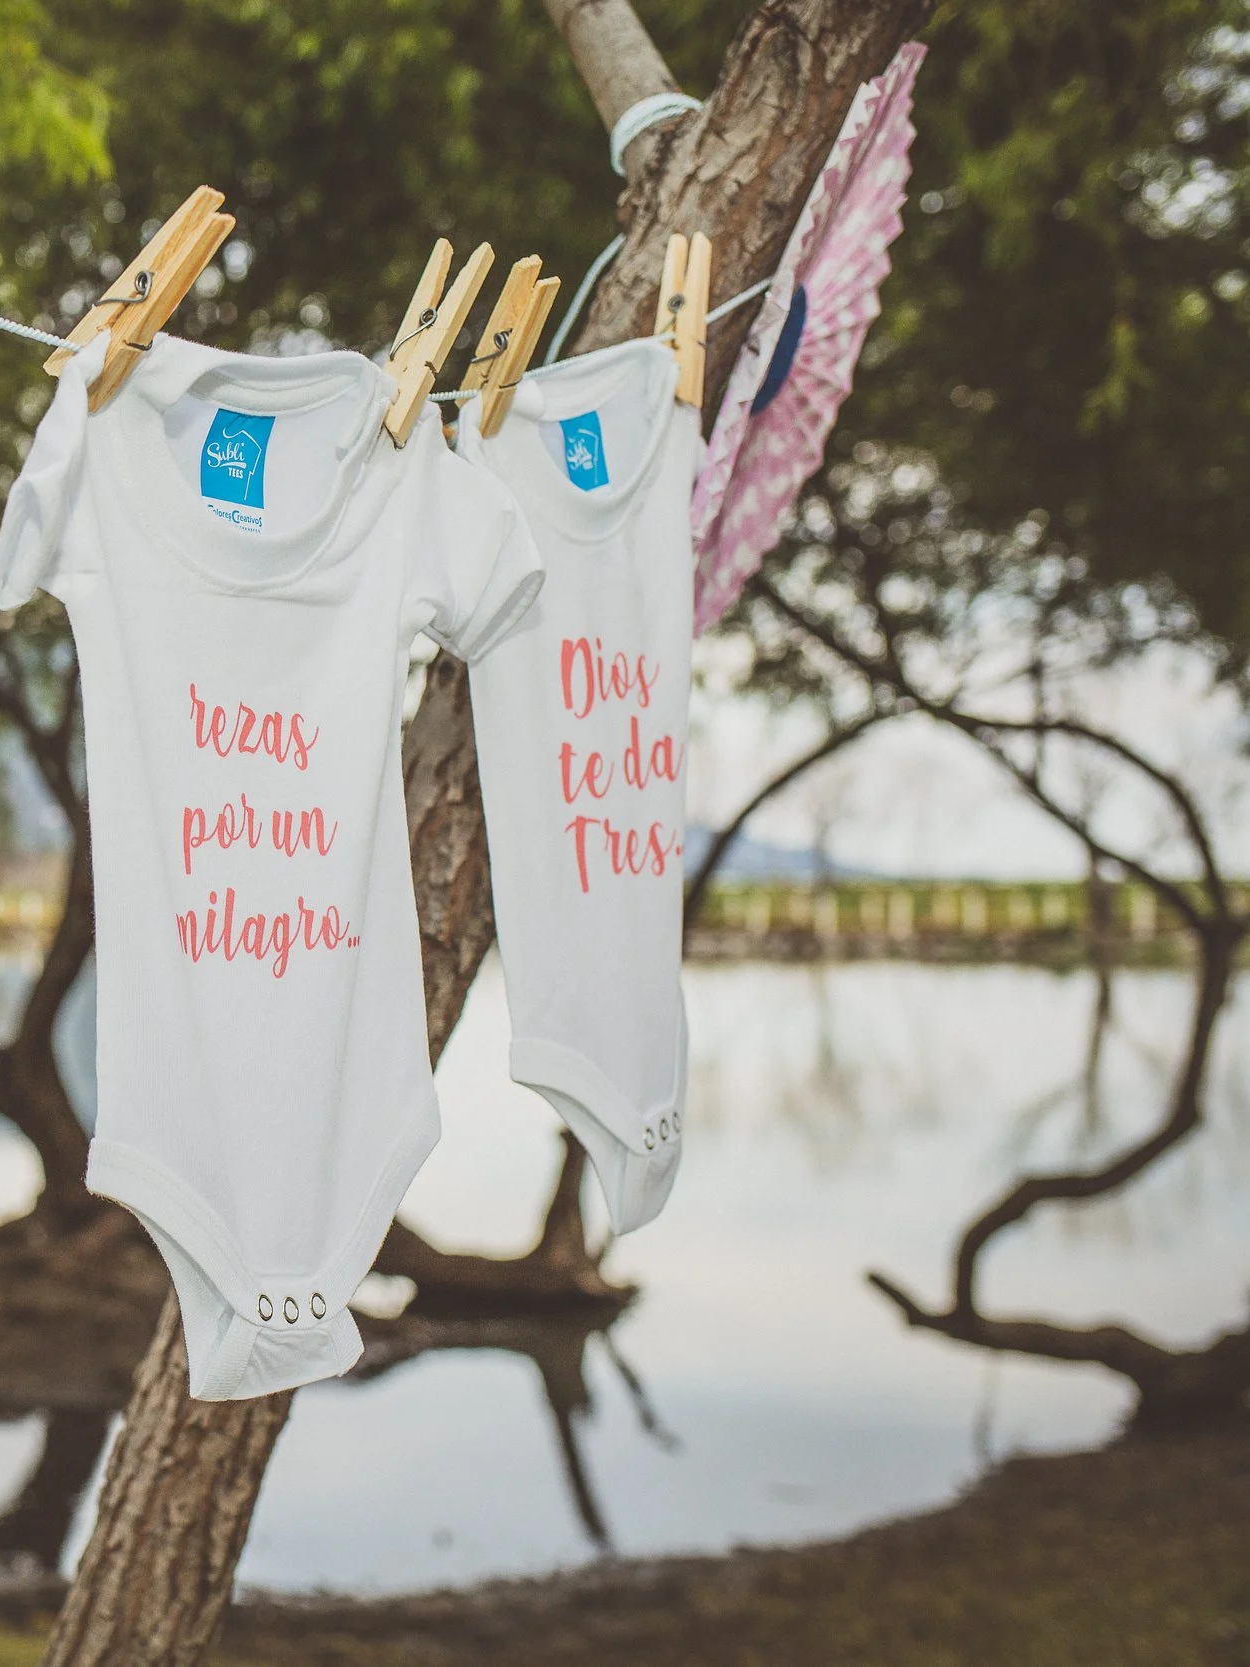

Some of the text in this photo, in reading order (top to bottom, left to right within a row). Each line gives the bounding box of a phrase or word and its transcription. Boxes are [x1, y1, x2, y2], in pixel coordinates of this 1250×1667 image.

[207, 442, 245, 468] Subli
[228, 467, 244, 479] TEES
[560, 637, 660, 719] Dios
[190, 683, 319, 771] rezas
[558, 715, 684, 804] te da
[183, 792, 338, 875] por un
